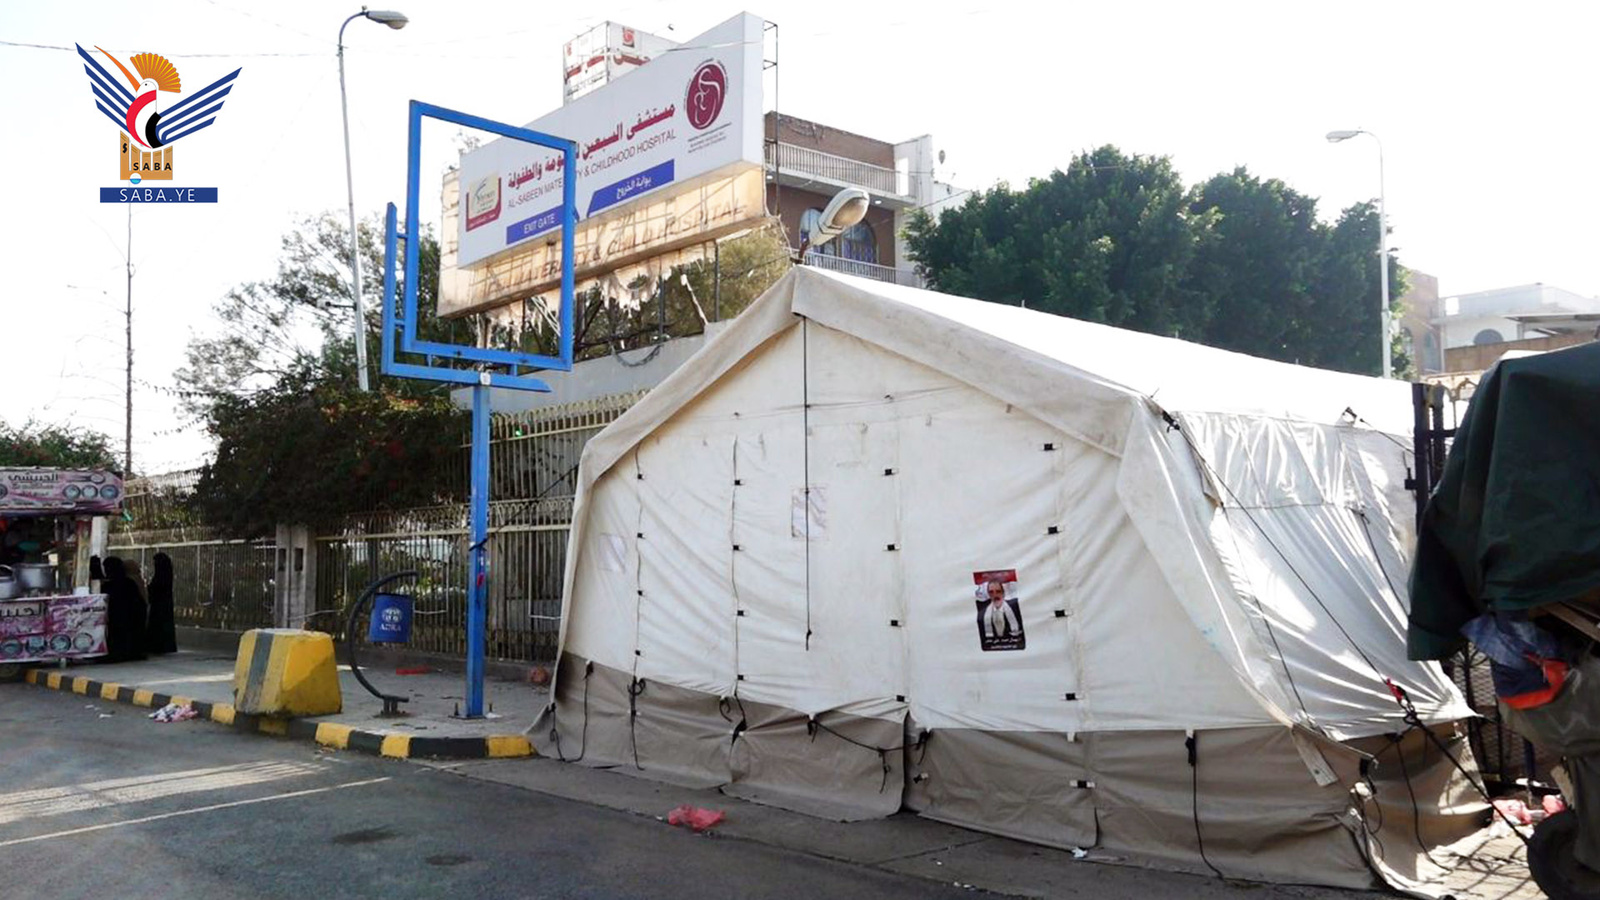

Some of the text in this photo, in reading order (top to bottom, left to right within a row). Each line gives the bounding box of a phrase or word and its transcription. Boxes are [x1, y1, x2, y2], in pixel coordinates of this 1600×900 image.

[627, 103, 675, 140] مستشفى
[582, 122, 622, 160] السبعين
[508, 184, 543, 209] AL-SABEEN
[583, 165, 591, 178] &
[590, 146, 636, 174] CHILDHOOD
[636, 128, 677, 154] HOSPITAL
[508, 161, 542, 190] والطفولة
[523, 213, 555, 235] EXIT GATE
